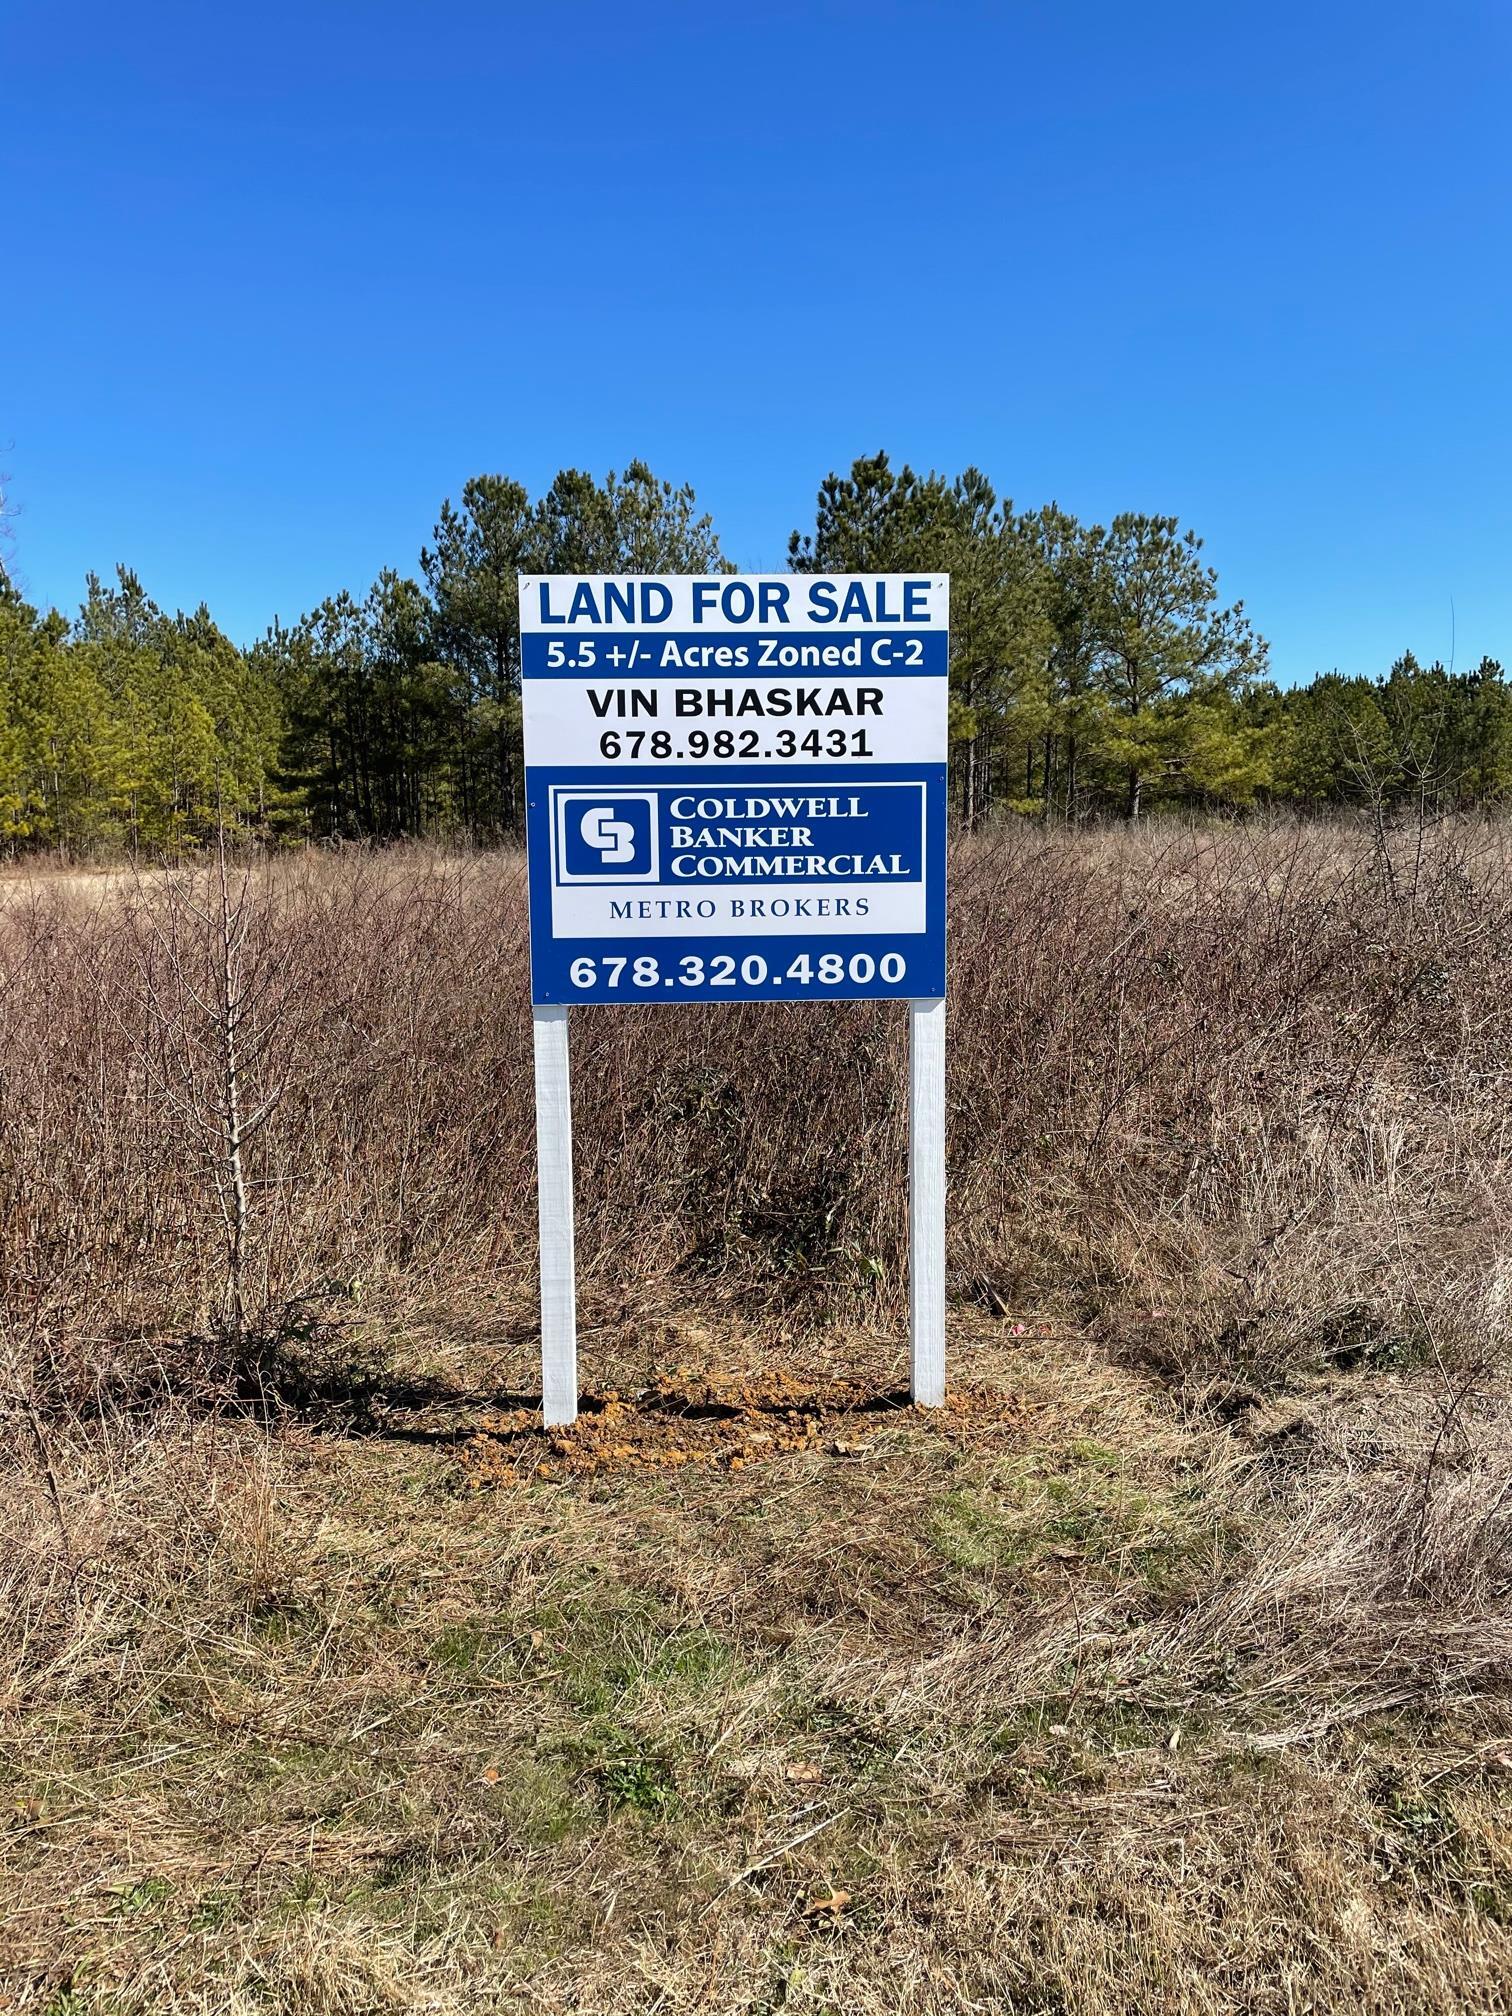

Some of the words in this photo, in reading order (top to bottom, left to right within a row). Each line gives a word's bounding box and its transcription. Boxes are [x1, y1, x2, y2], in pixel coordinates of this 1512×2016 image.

[539, 582, 673, 624] LAND
[693, 581, 790, 624] FOR
[807, 580, 932, 623] SALE
[547, 641, 596, 668] 5.5
[605, 640, 652, 669] +/-
[660, 640, 750, 668] Acres
[758, 639, 862, 667] Zoned
[871, 638, 924, 666] C-2
[586, 689, 658, 718] VIN
[675, 687, 884, 717] BHASKAR
[600, 728, 873, 760] 678.982.3431
[670, 796, 869, 820] COLDWELL
[670, 826, 814, 848] BANKER
[671, 854, 910, 878] COMMERCIAL
[610, 899, 717, 919] METRO
[731, 897, 870, 917] BROKERS
[569, 953, 907, 988] 678.320.4800
